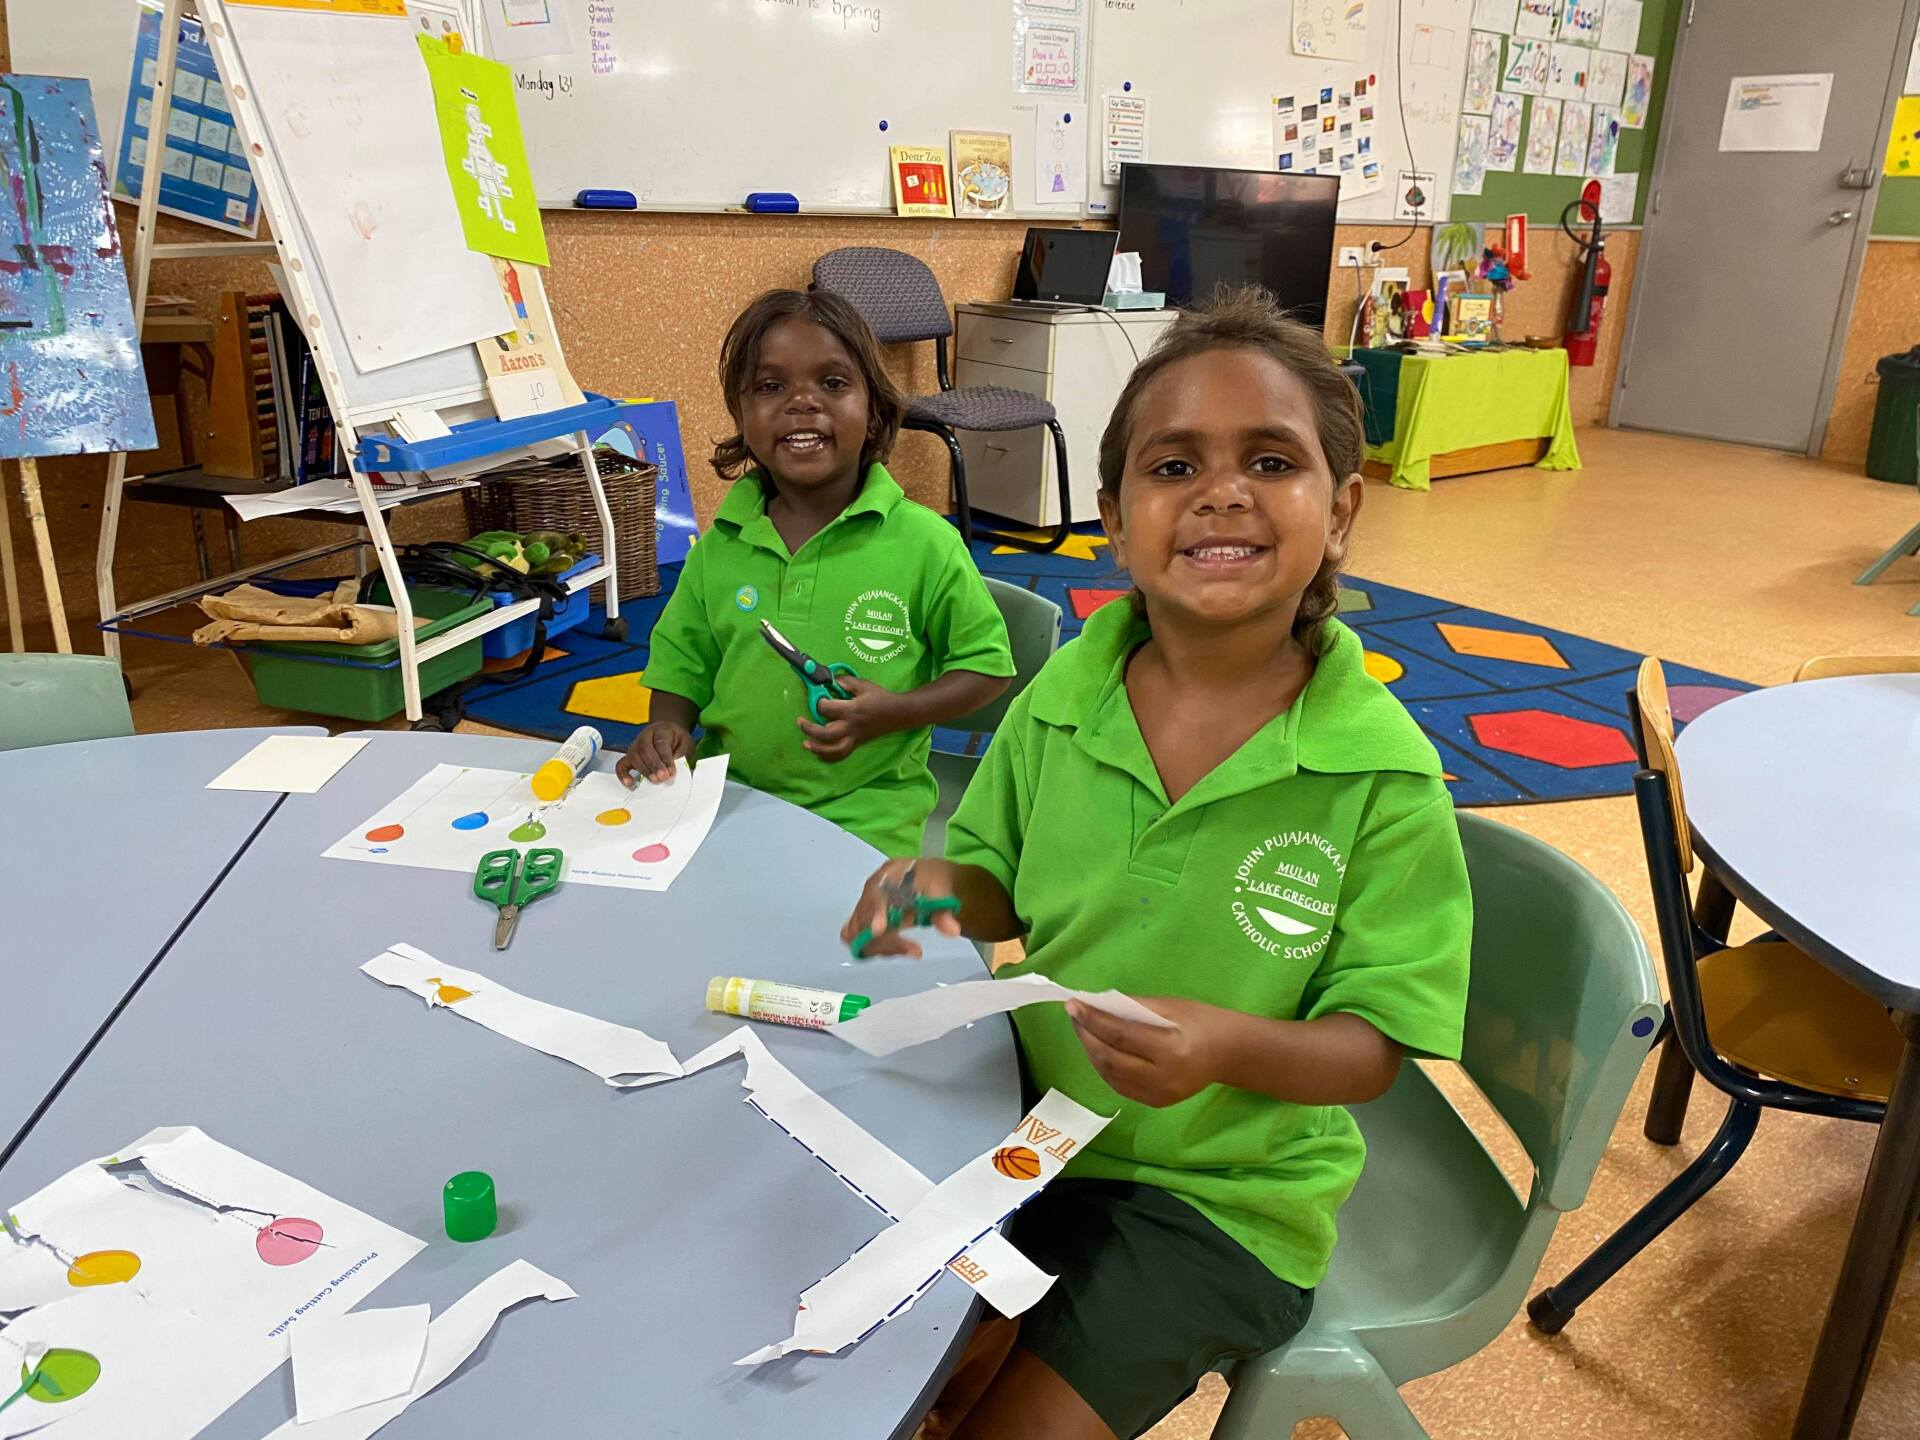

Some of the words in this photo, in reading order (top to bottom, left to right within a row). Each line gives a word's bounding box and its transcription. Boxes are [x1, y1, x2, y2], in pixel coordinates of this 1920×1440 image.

[832, 0, 881, 33] Spring
[592, 39, 611, 50] Blue
[515, 69, 554, 100] Monday
[900, 151, 923, 161] Dear
[925, 151, 941, 163] Zoo
[499, 353, 546, 373] Aaron's
[308, 408, 321, 421] TEN
[657, 442, 668, 482] Saucer
[844, 601, 859, 625] JOHN
[866, 609, 893, 620] MULAN
[852, 621, 872, 631] LAKE
[872, 624, 905, 635] GREGORY
[845, 636, 878, 663] CATHOLIC
[880, 643, 907, 663] SCHOOL
[1235, 847, 1265, 884] JOHN
[1276, 861, 1320, 886] MULAN
[1249, 880, 1281, 897] LAKE
[1283, 889, 1337, 914] GREGORY
[1232, 901, 1280, 956] CATHOLIC
[1284, 930, 1332, 959] SCHOO
[330, 1252, 379, 1287] Practising
[294, 1287, 333, 1316] Cutting
[268, 1315, 297, 1338] Skills
